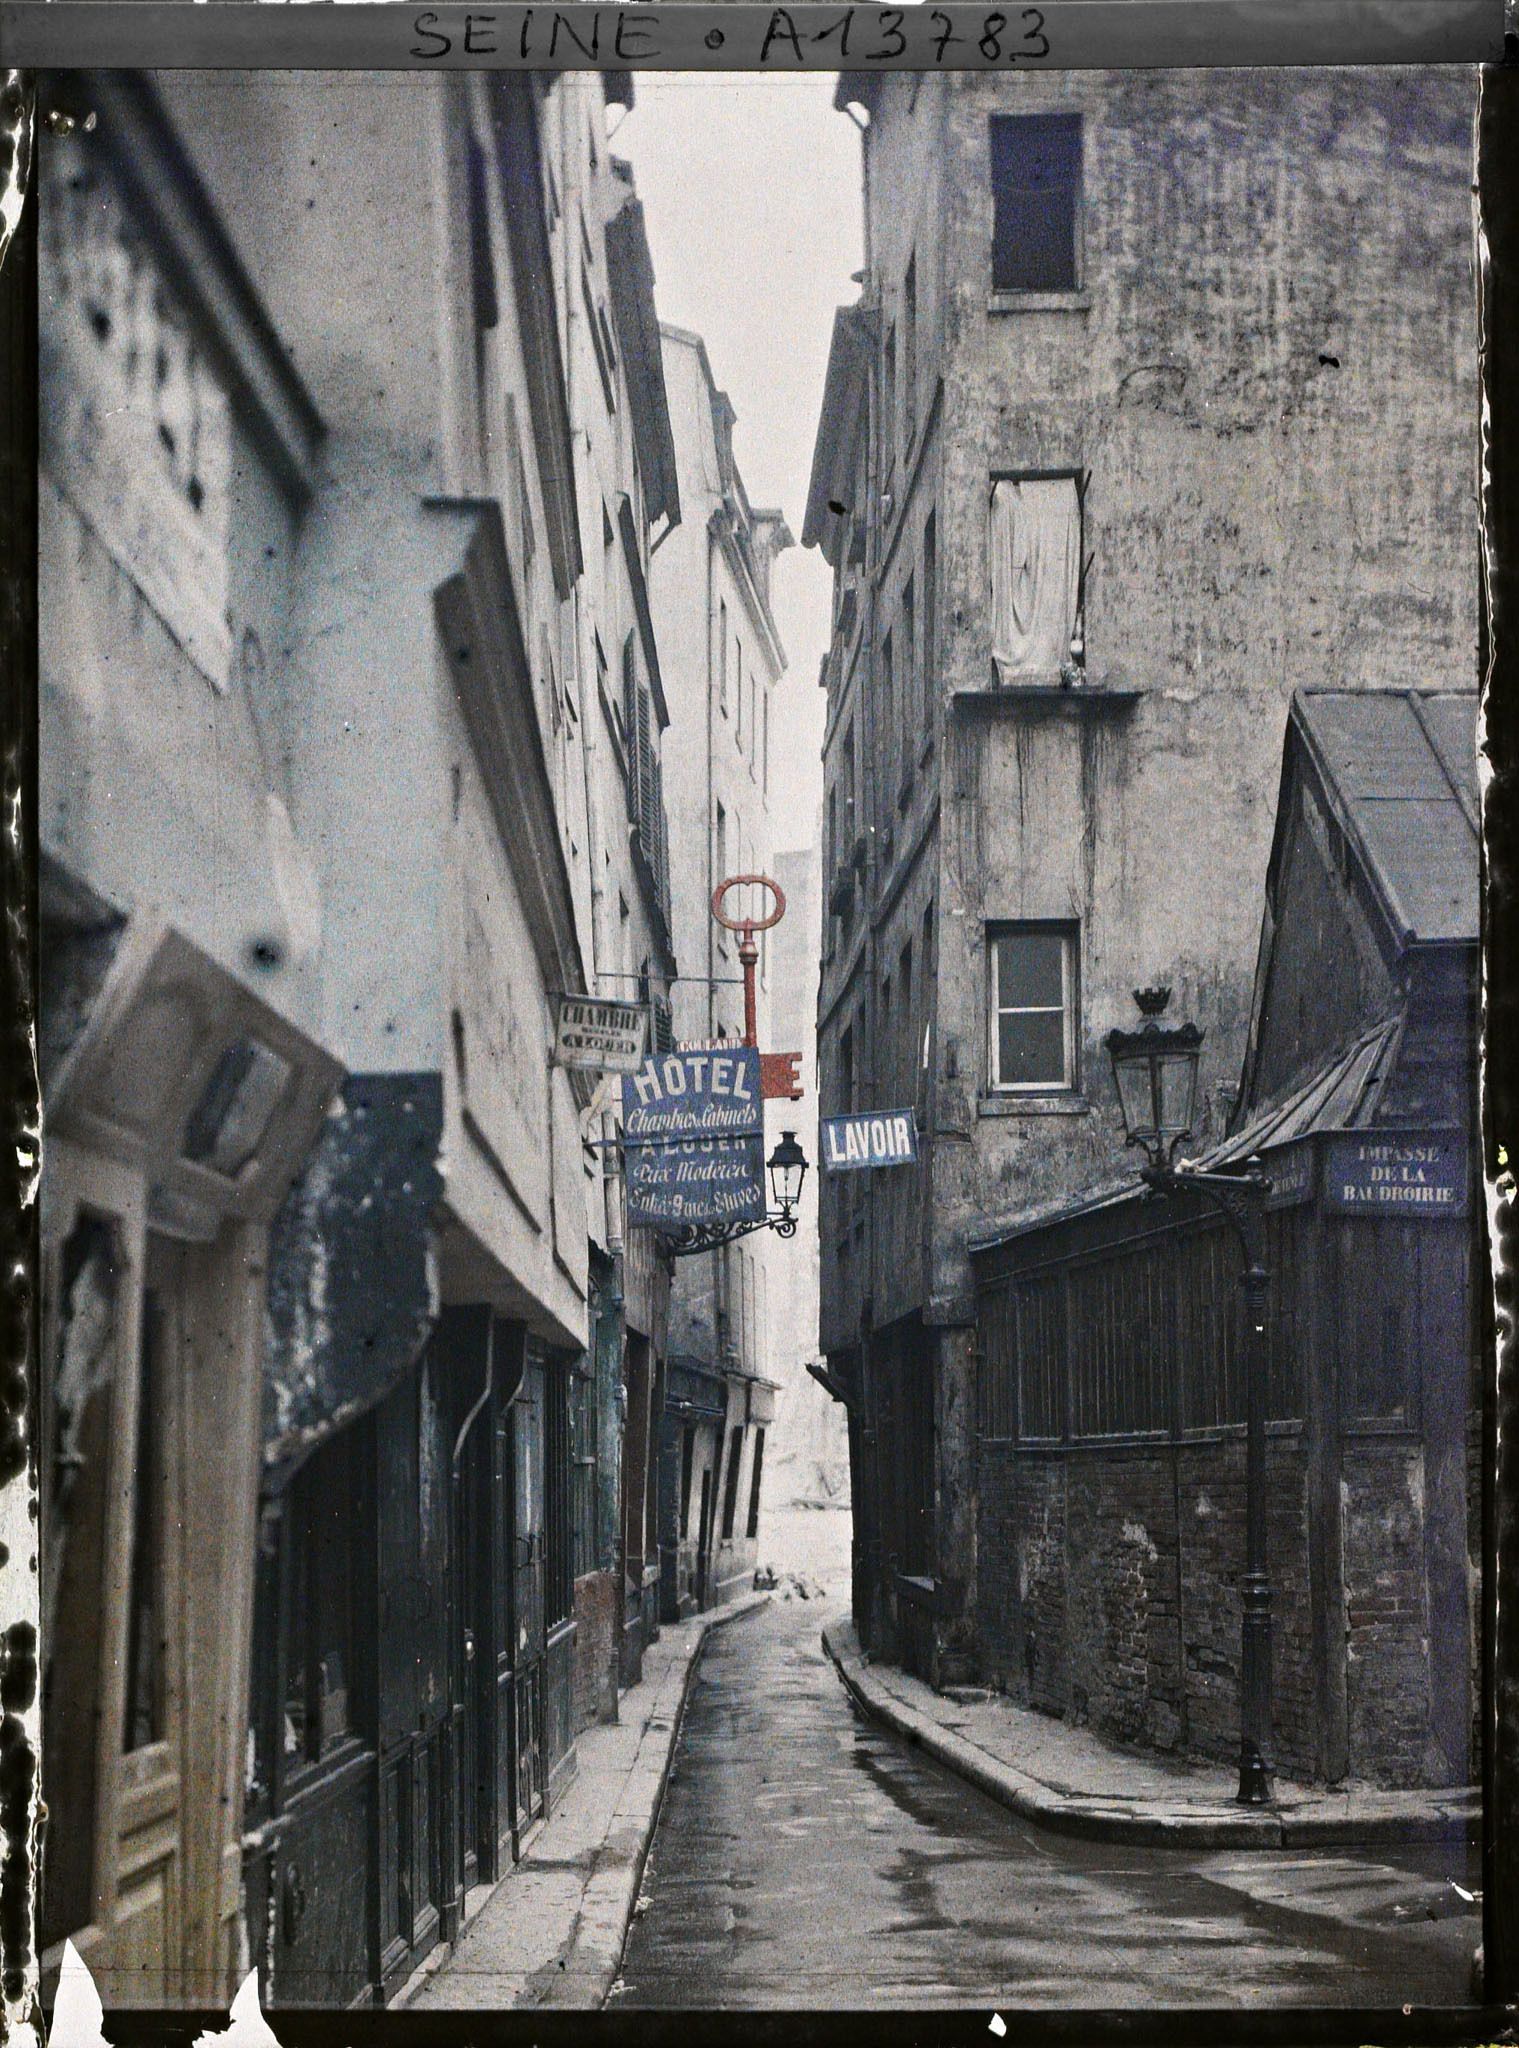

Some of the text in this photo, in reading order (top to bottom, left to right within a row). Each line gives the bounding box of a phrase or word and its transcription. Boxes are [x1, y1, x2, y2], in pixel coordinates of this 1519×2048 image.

[411, 14, 660, 58] SEINE
[633, 1055, 752, 1106] HÔTEL
[828, 1117, 911, 1162] LAVOIR
[1359, 1146, 1440, 1162] IMPASSE
[1371, 1166, 1426, 1182] DE LA
[1344, 1185, 1455, 1202] BAUDROIRIE
